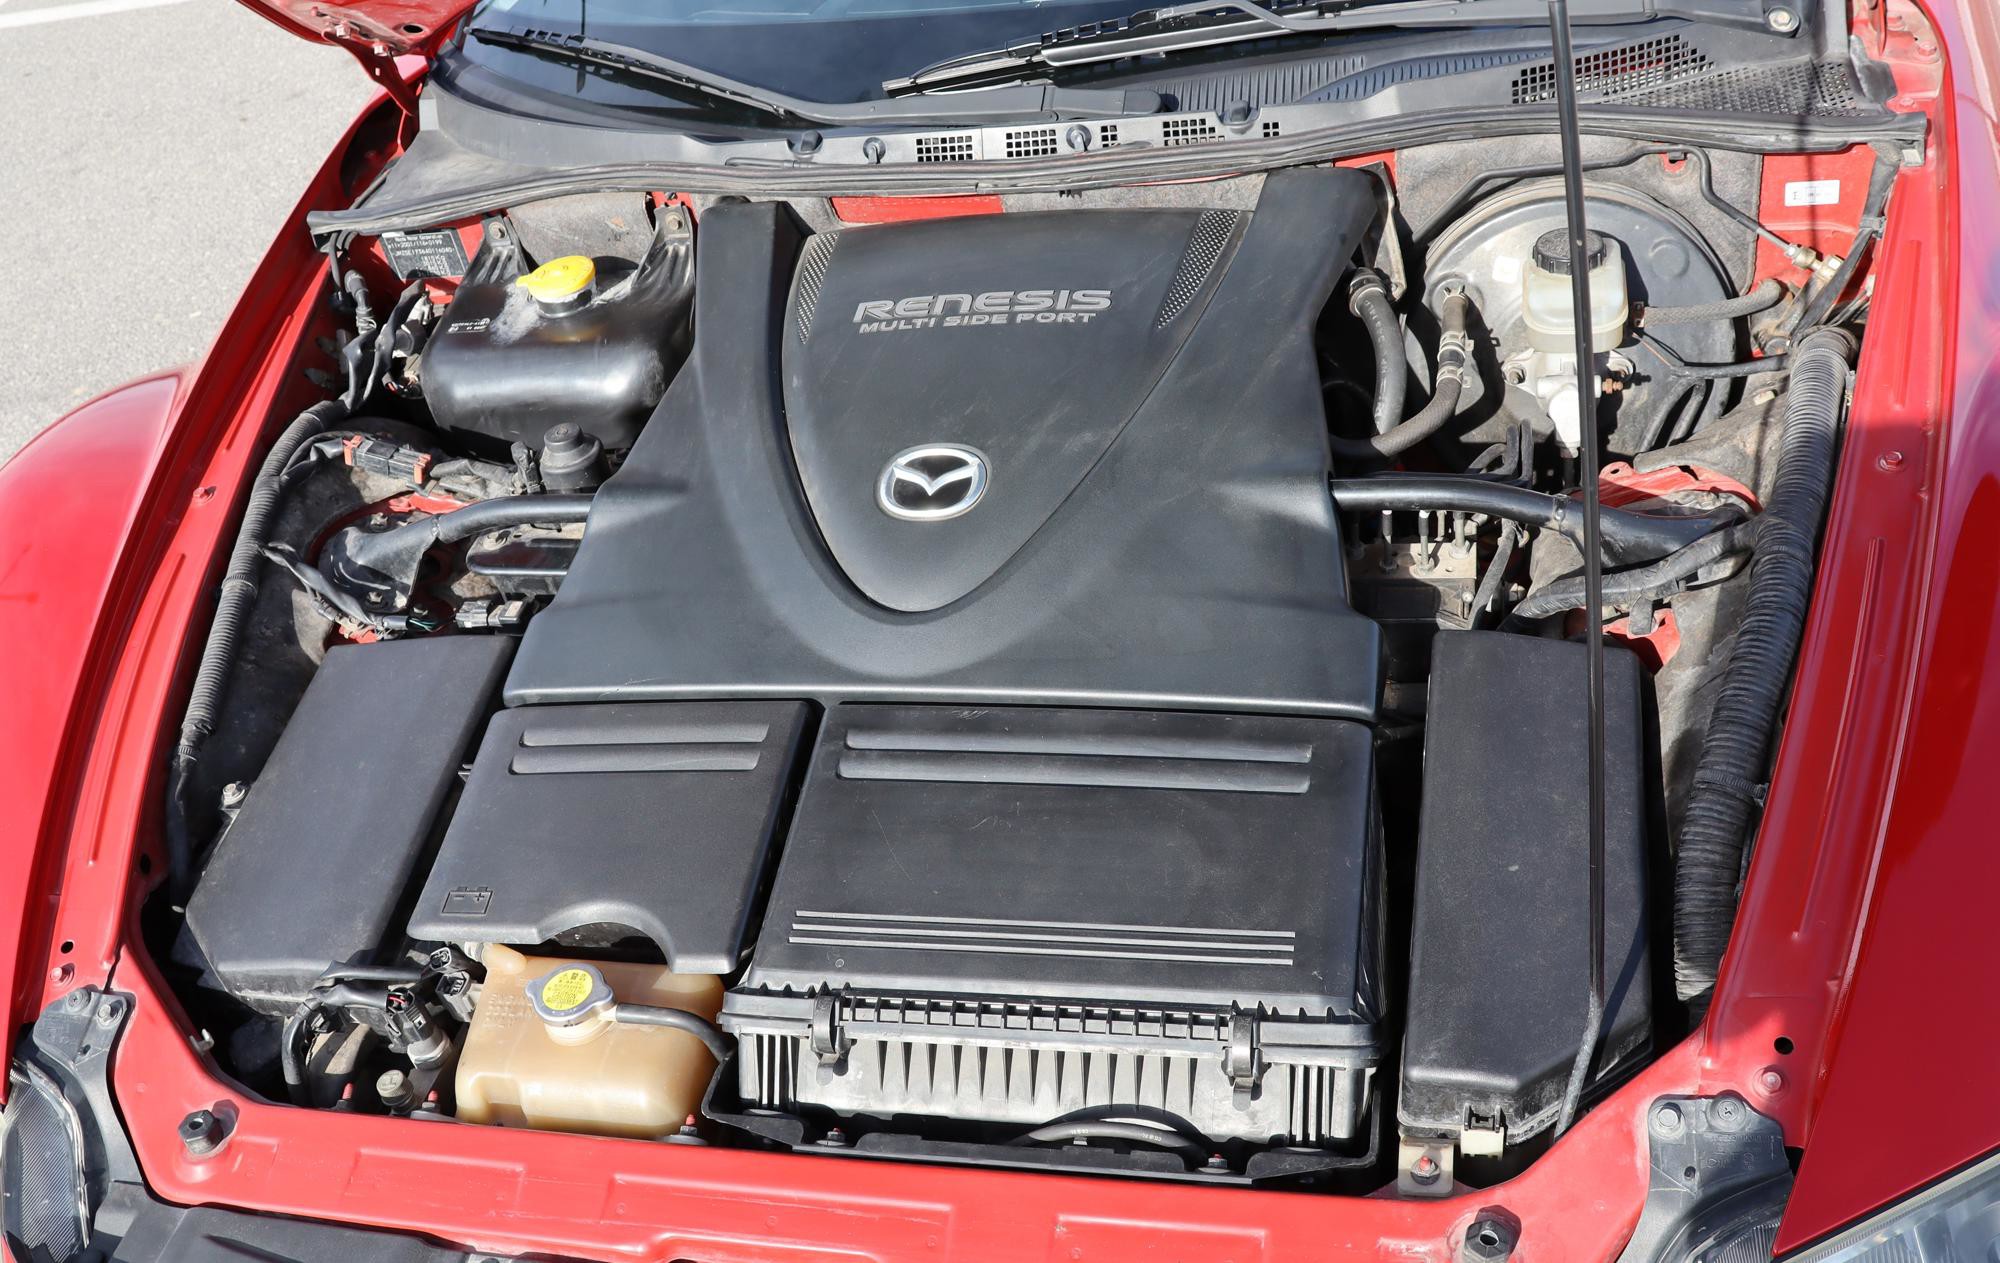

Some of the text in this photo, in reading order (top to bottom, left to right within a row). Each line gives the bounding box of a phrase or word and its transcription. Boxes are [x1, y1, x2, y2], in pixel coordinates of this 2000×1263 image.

[853, 289, 1112, 323] RENESIS
[859, 312, 1097, 334] MULTI SIDE PORT
